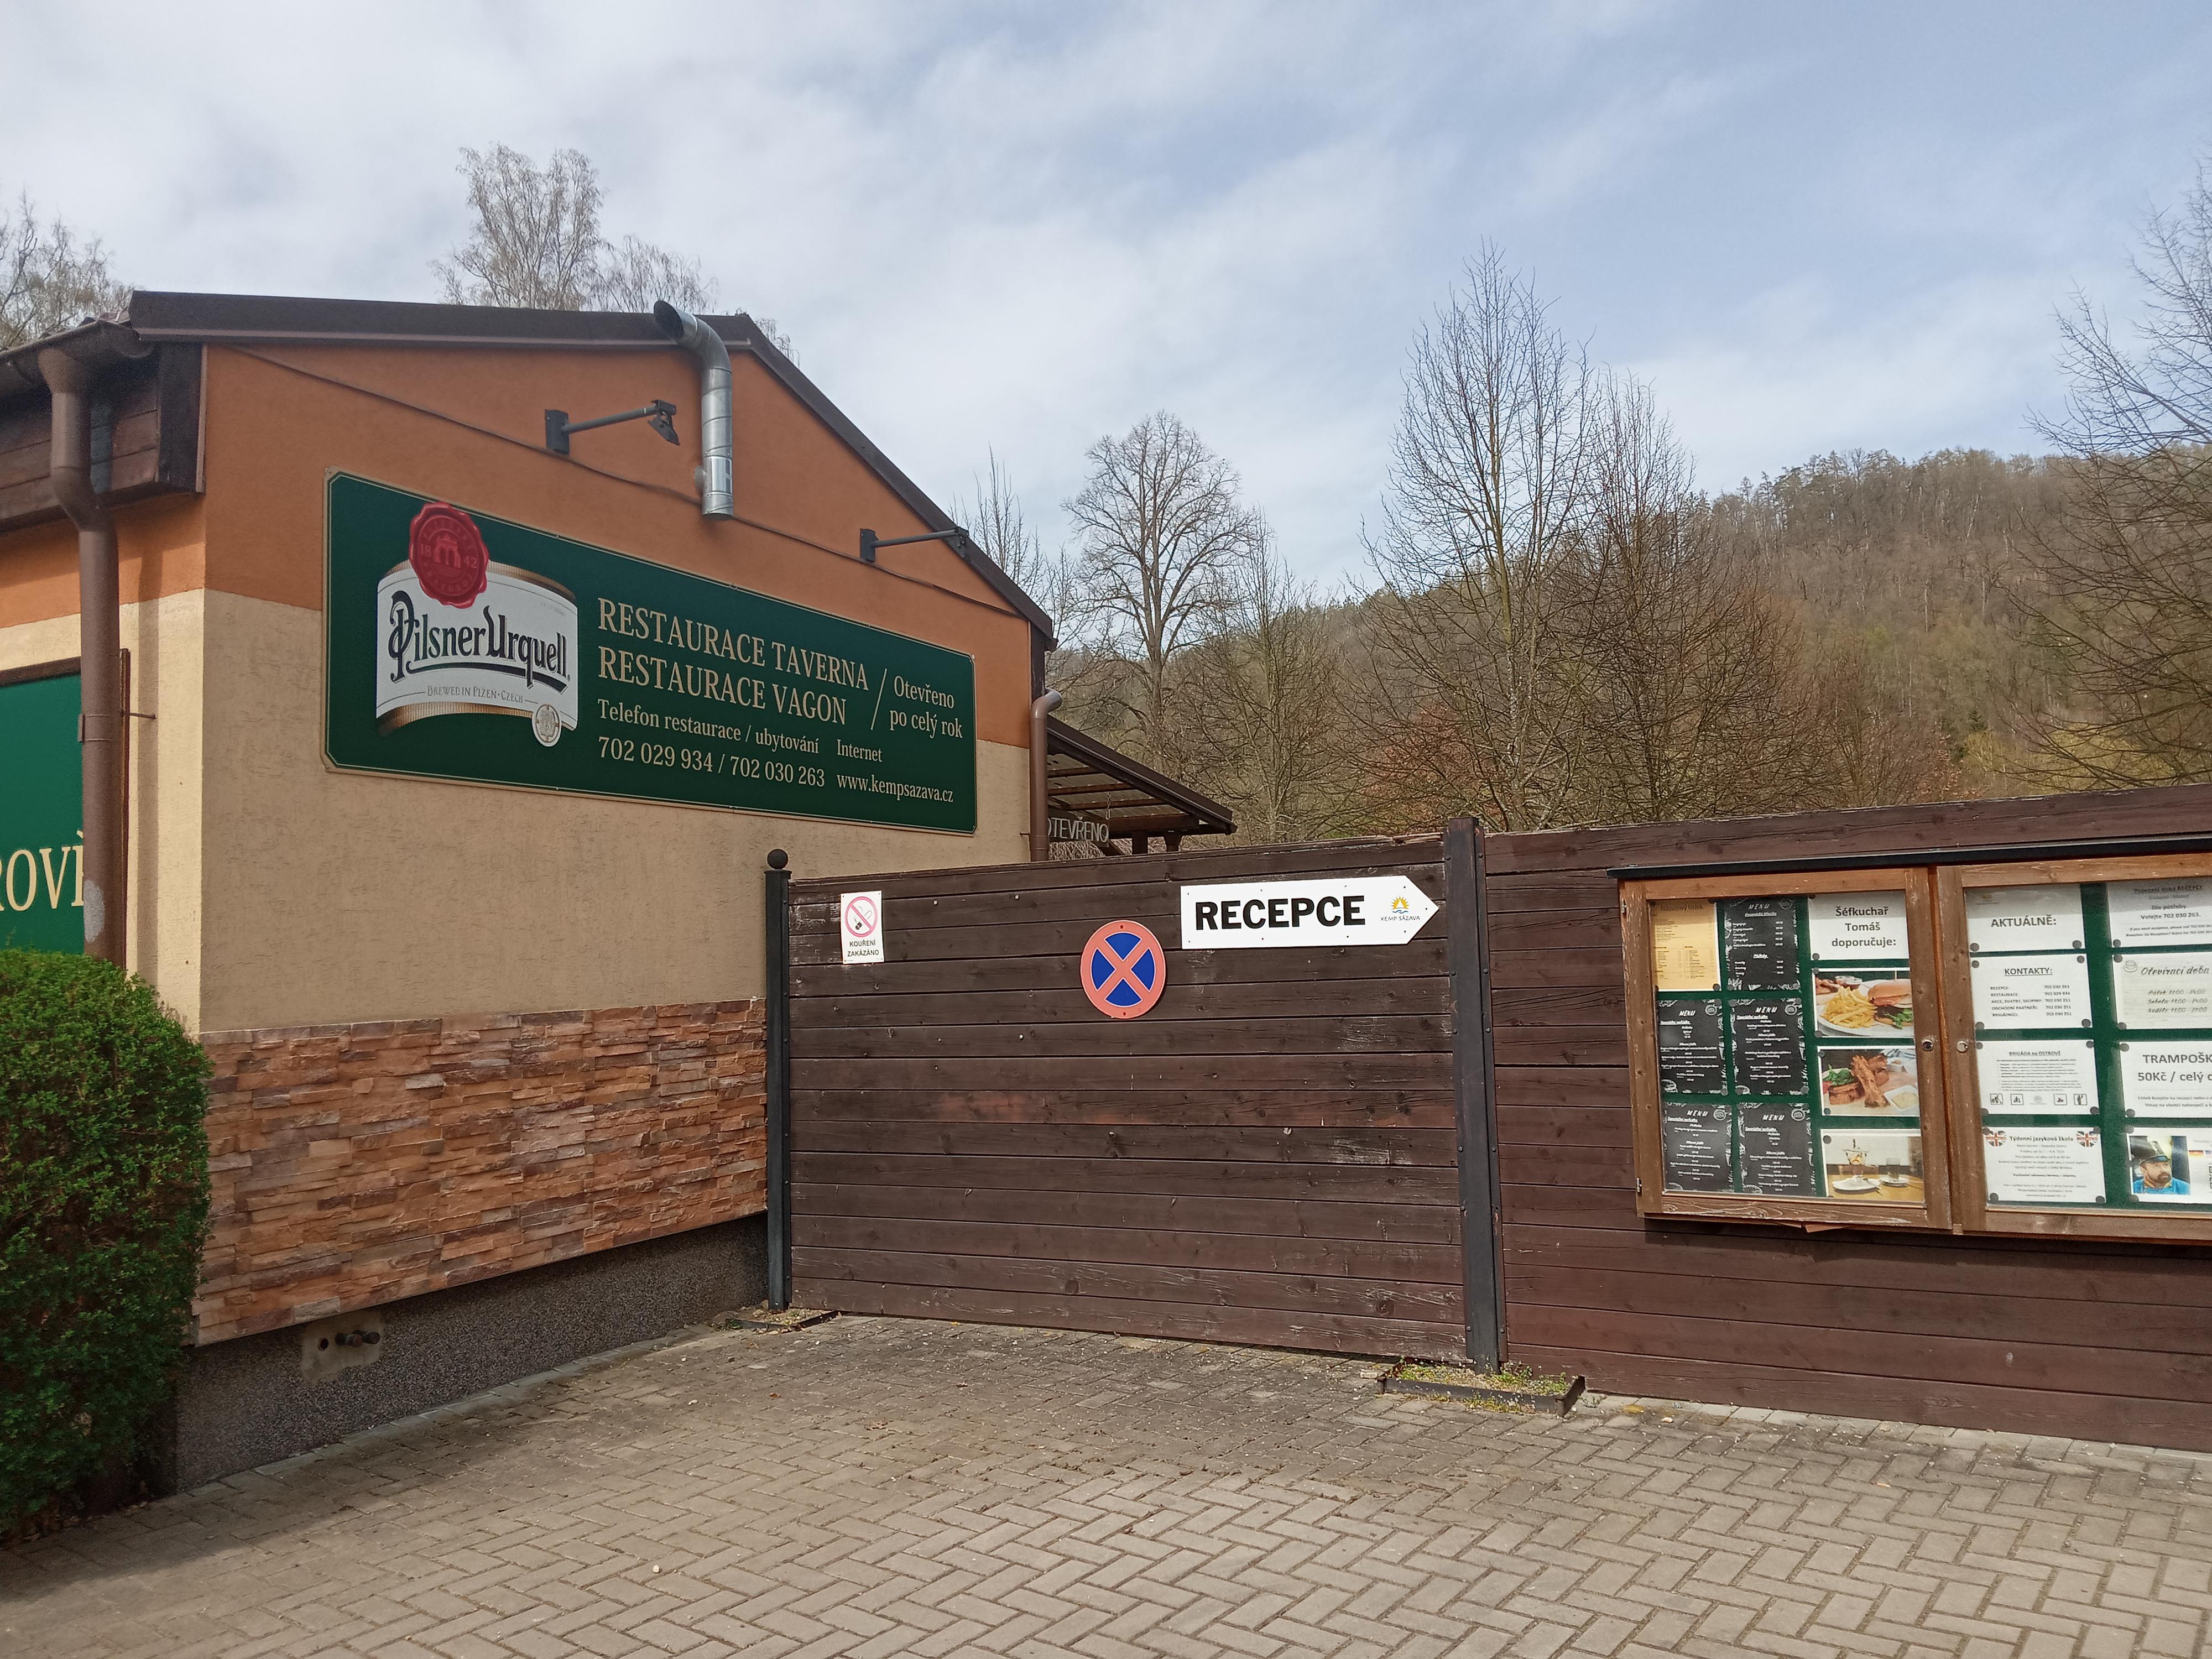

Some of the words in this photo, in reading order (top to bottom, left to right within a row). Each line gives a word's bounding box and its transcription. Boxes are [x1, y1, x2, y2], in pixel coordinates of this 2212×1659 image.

[598, 597, 765, 667] RESTAURACE
[771, 641, 869, 691] TAVERNA
[598, 645, 766, 709] RESTAURACE
[771, 684, 846, 726] VAGON
[894, 675, 954, 709] Otevřeno
[598, 698, 660, 728] Telefon
[664, 715, 741, 741] restaurace
[755, 728, 819, 754] ubytování
[837, 739, 883, 763] Internet
[890, 709, 907, 731] po
[911, 711, 937, 739] celý
[941, 718, 963, 739] rok
[598, 736, 634, 762] 702
[640, 742, 676, 767] 029
[680, 748, 713, 773] 934
[730, 755, 760, 779] 702
[765, 760, 794, 784] 030
[798, 765, 825, 787] 263
[837, 774, 954, 803] www.kempsazava.cz
[0, 830, 84, 912] OV
[1195, 895, 1365, 931] RECEPCE
[1835, 906, 1888, 916] Šéfkuchař
[1991, 914, 2057, 927] AKTUÁLNĚ:
[1845, 922, 1880, 931] Tomáš
[1832, 937, 1897, 948] doporučuje:
[2141, 967, 2185, 975] Otevírací
[2186, 965, 2209, 974] doba
[2142, 1052, 2212, 1063] TRAMPOŠK
[2137, 1072, 2167, 1081] 50Kč
[2180, 1071, 2204, 1083] celý
